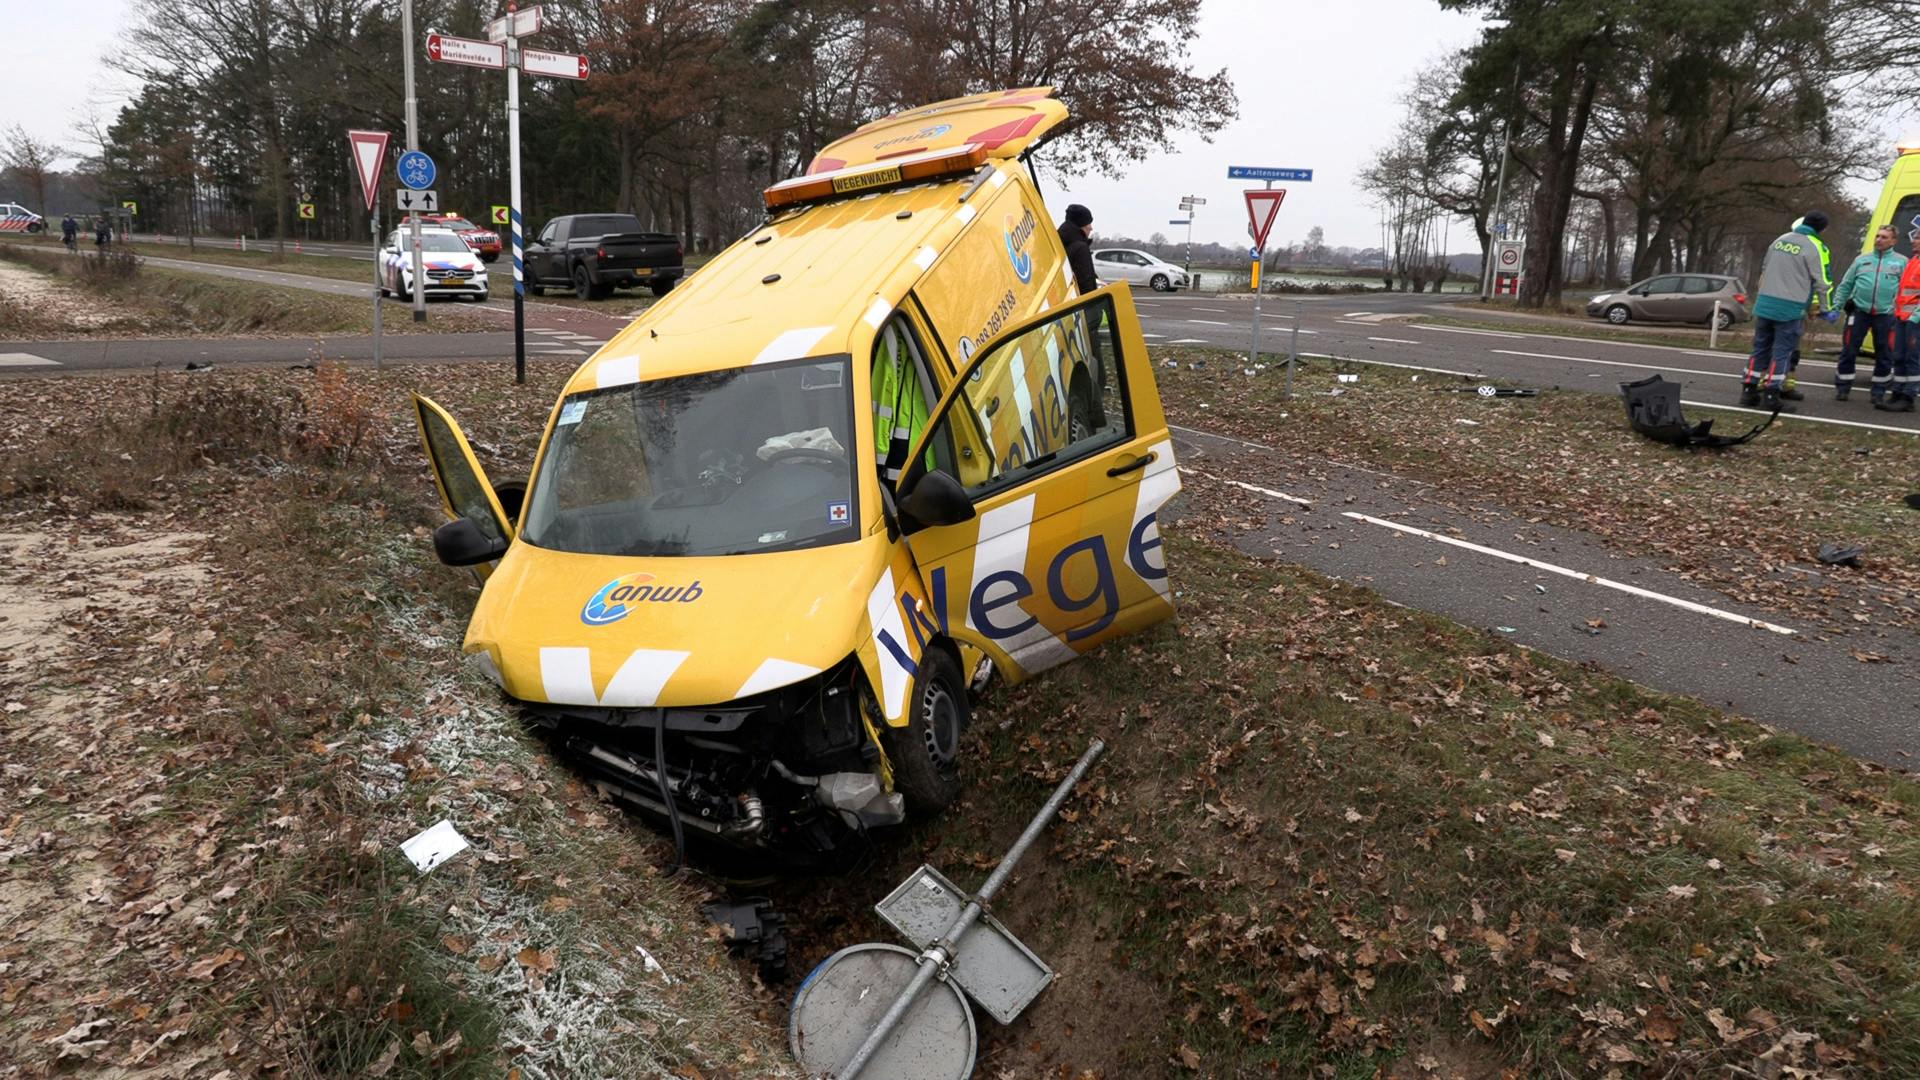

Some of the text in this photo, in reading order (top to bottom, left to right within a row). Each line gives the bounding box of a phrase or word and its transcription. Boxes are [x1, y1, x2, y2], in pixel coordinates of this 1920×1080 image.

[441, 39, 461, 49] Halle
[525, 51, 552, 61] Hengelo
[834, 167, 900, 190] WEGENWACHT
[1246, 169, 1295, 179] Aaltenseweg
[1010, 203, 1036, 252] anwb
[987, 311, 1002, 336] 269
[998, 299, 1009, 321] 28
[1005, 289, 1016, 310] 88
[610, 580, 703, 603] anwb
